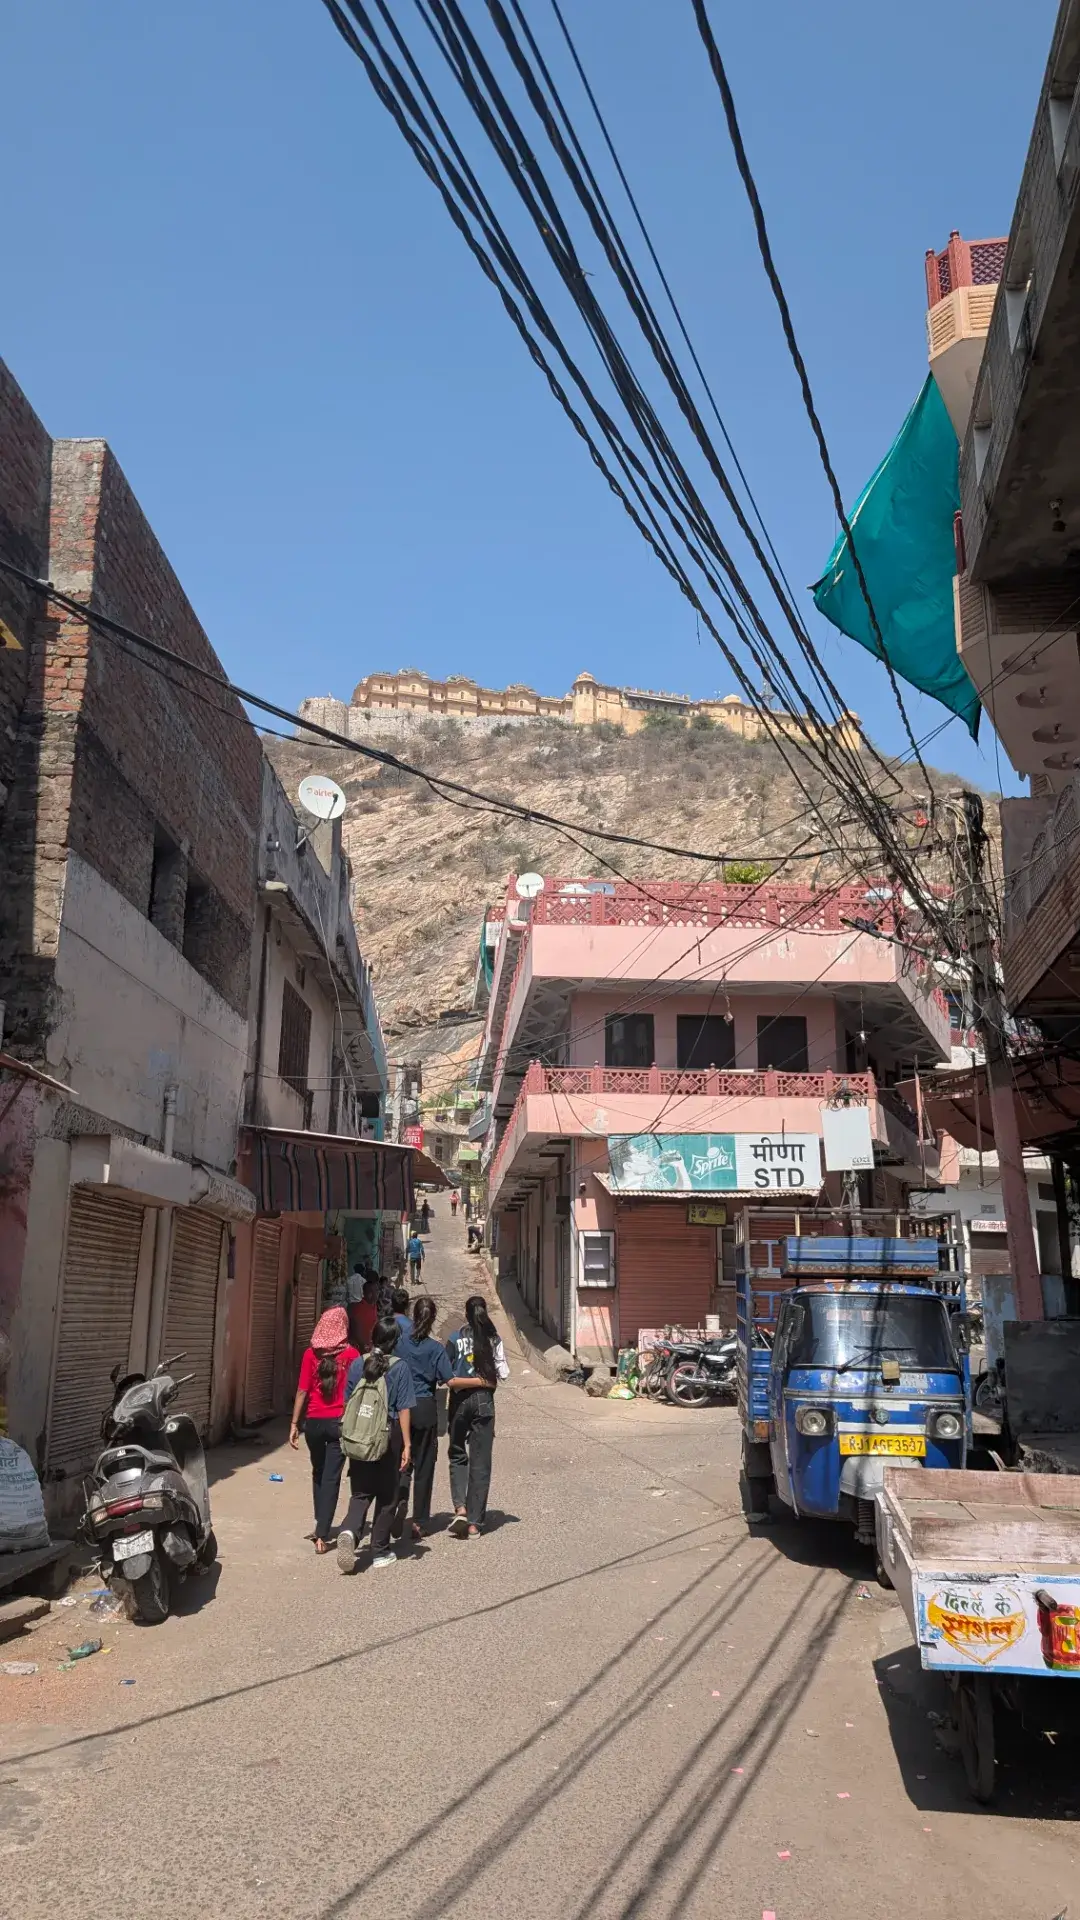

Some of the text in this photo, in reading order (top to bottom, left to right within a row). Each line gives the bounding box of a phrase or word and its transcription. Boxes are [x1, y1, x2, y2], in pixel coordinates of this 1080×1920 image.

[749, 1137, 806, 1163] मीणा
[693, 1151, 730, 1175] Sprite
[754, 1168, 805, 1188] STD
[994, 1593, 1011, 1617] के
